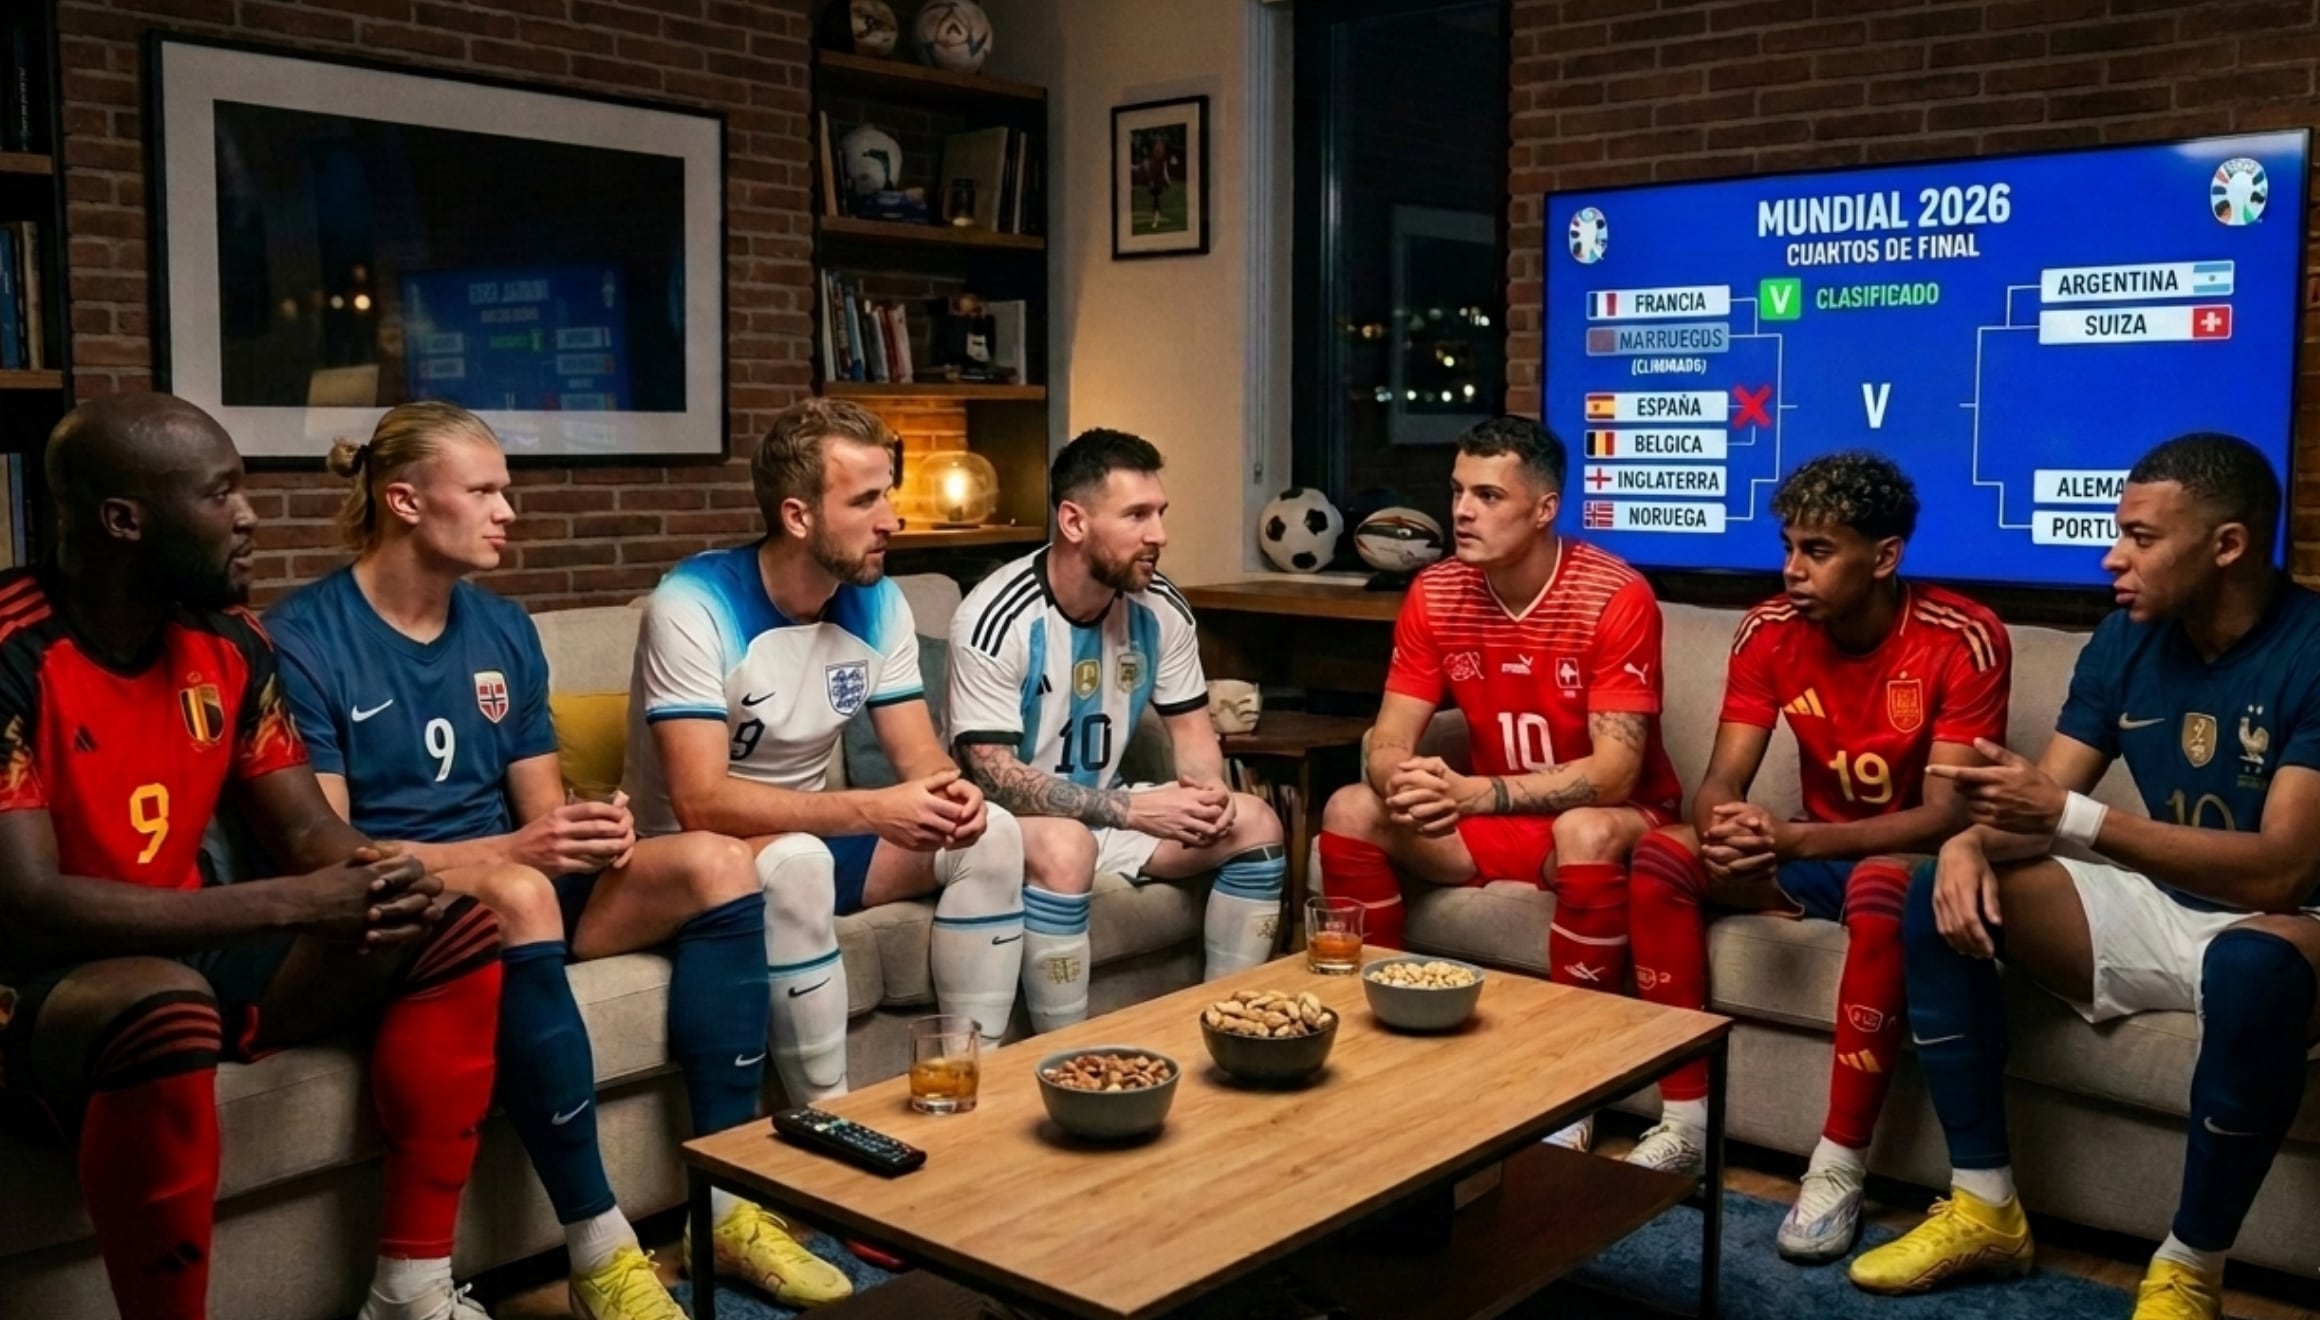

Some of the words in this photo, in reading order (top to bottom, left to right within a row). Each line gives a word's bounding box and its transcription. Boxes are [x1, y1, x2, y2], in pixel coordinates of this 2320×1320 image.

[1758, 190, 1909, 237] MUNDIAL
[1918, 183, 2011, 228] 2026
[1885, 237, 1913, 262] DE
[1918, 233, 1980, 260] FINAL
[2058, 270, 2179, 296] ARGENTINA
[1635, 291, 1707, 313] FRANCIA
[2084, 313, 2147, 336] SUIZA
[1637, 393, 1702, 417] ESPAÑA
[1861, 382, 1892, 429] V
[1635, 434, 1703, 454] BELGICA
[1618, 470, 1720, 491] INGLATERRA
[1629, 506, 1707, 527] NORUEGA
[425, 717, 456, 782] 9
[730, 717, 766, 761] 9
[1055, 713, 1112, 774] 10
[1498, 711, 1555, 771] 10
[1828, 750, 1893, 804] 19
[130, 782, 170, 864] 9
